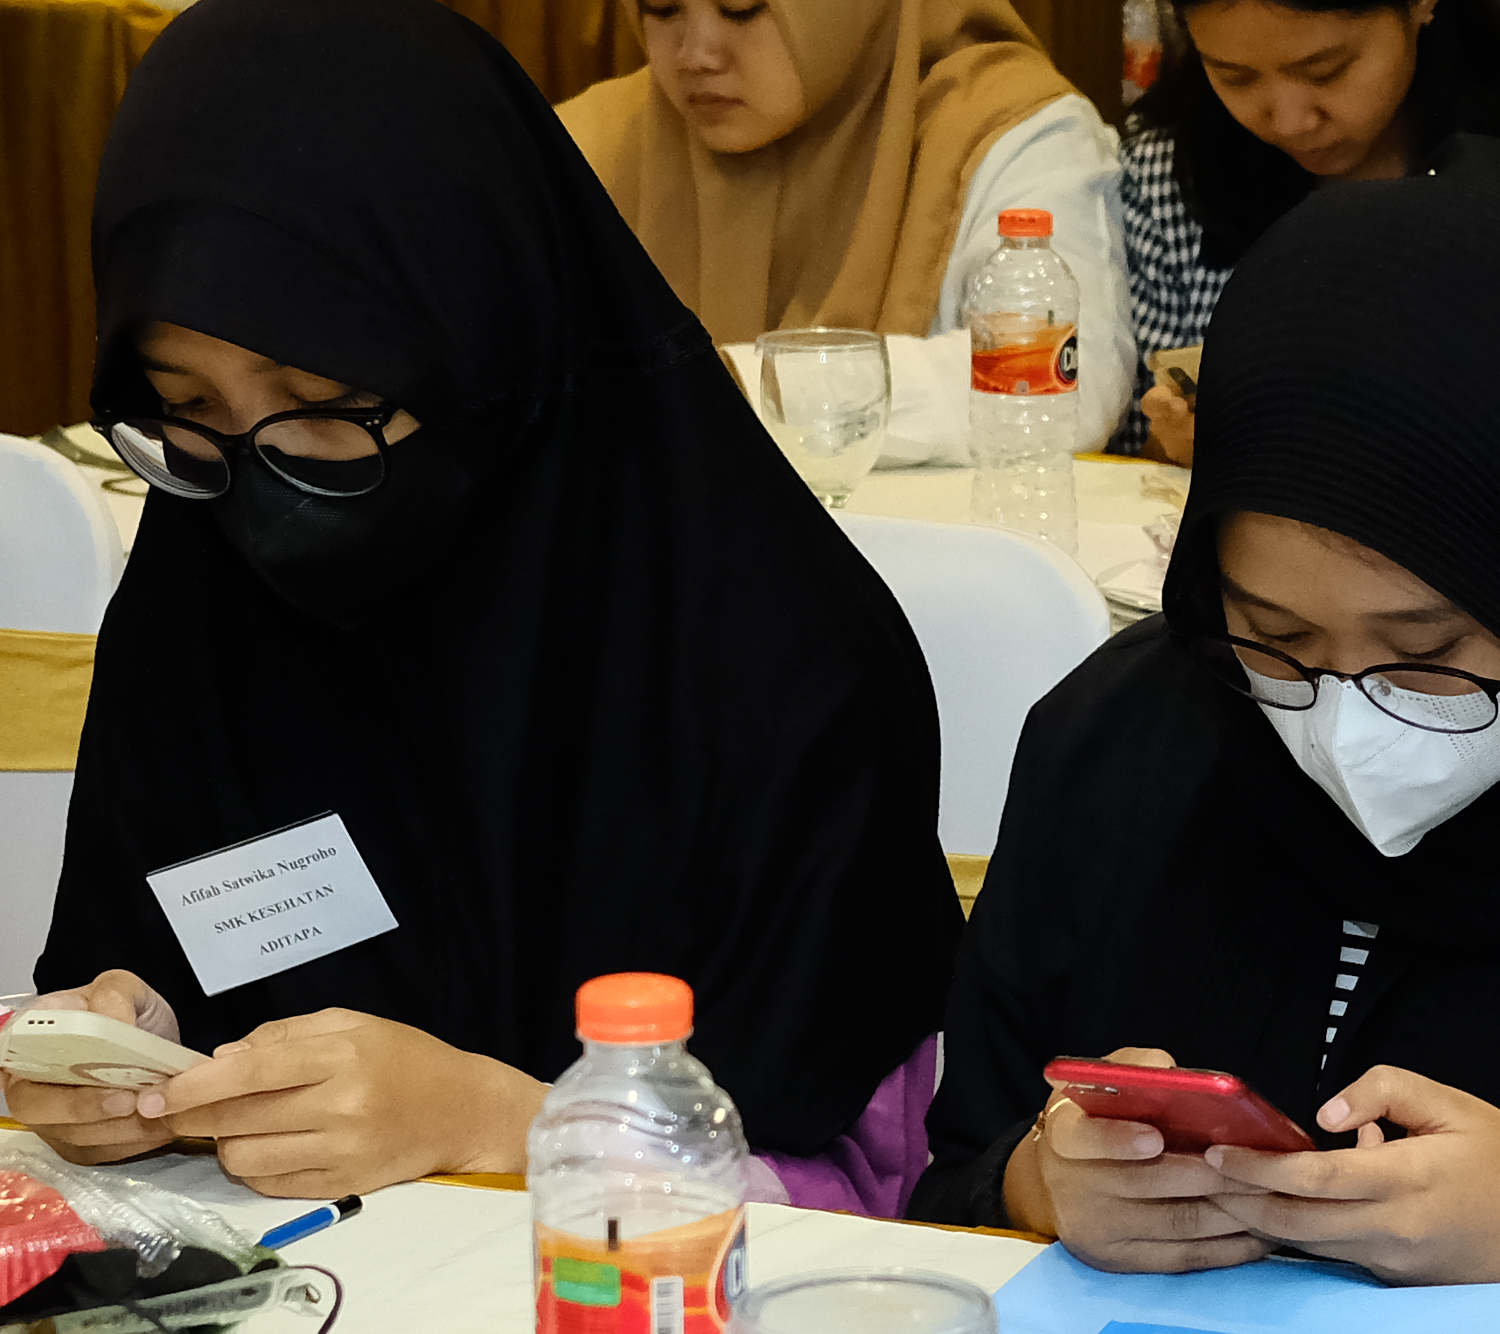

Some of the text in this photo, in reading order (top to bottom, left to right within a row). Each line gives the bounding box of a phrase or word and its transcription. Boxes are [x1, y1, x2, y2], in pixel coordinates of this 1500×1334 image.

[181, 846, 337, 906] Afifah Satwika Nugroho
[214, 884, 335, 934] SMK KESEHATAN
[259, 926, 323, 955] ADITAPA
